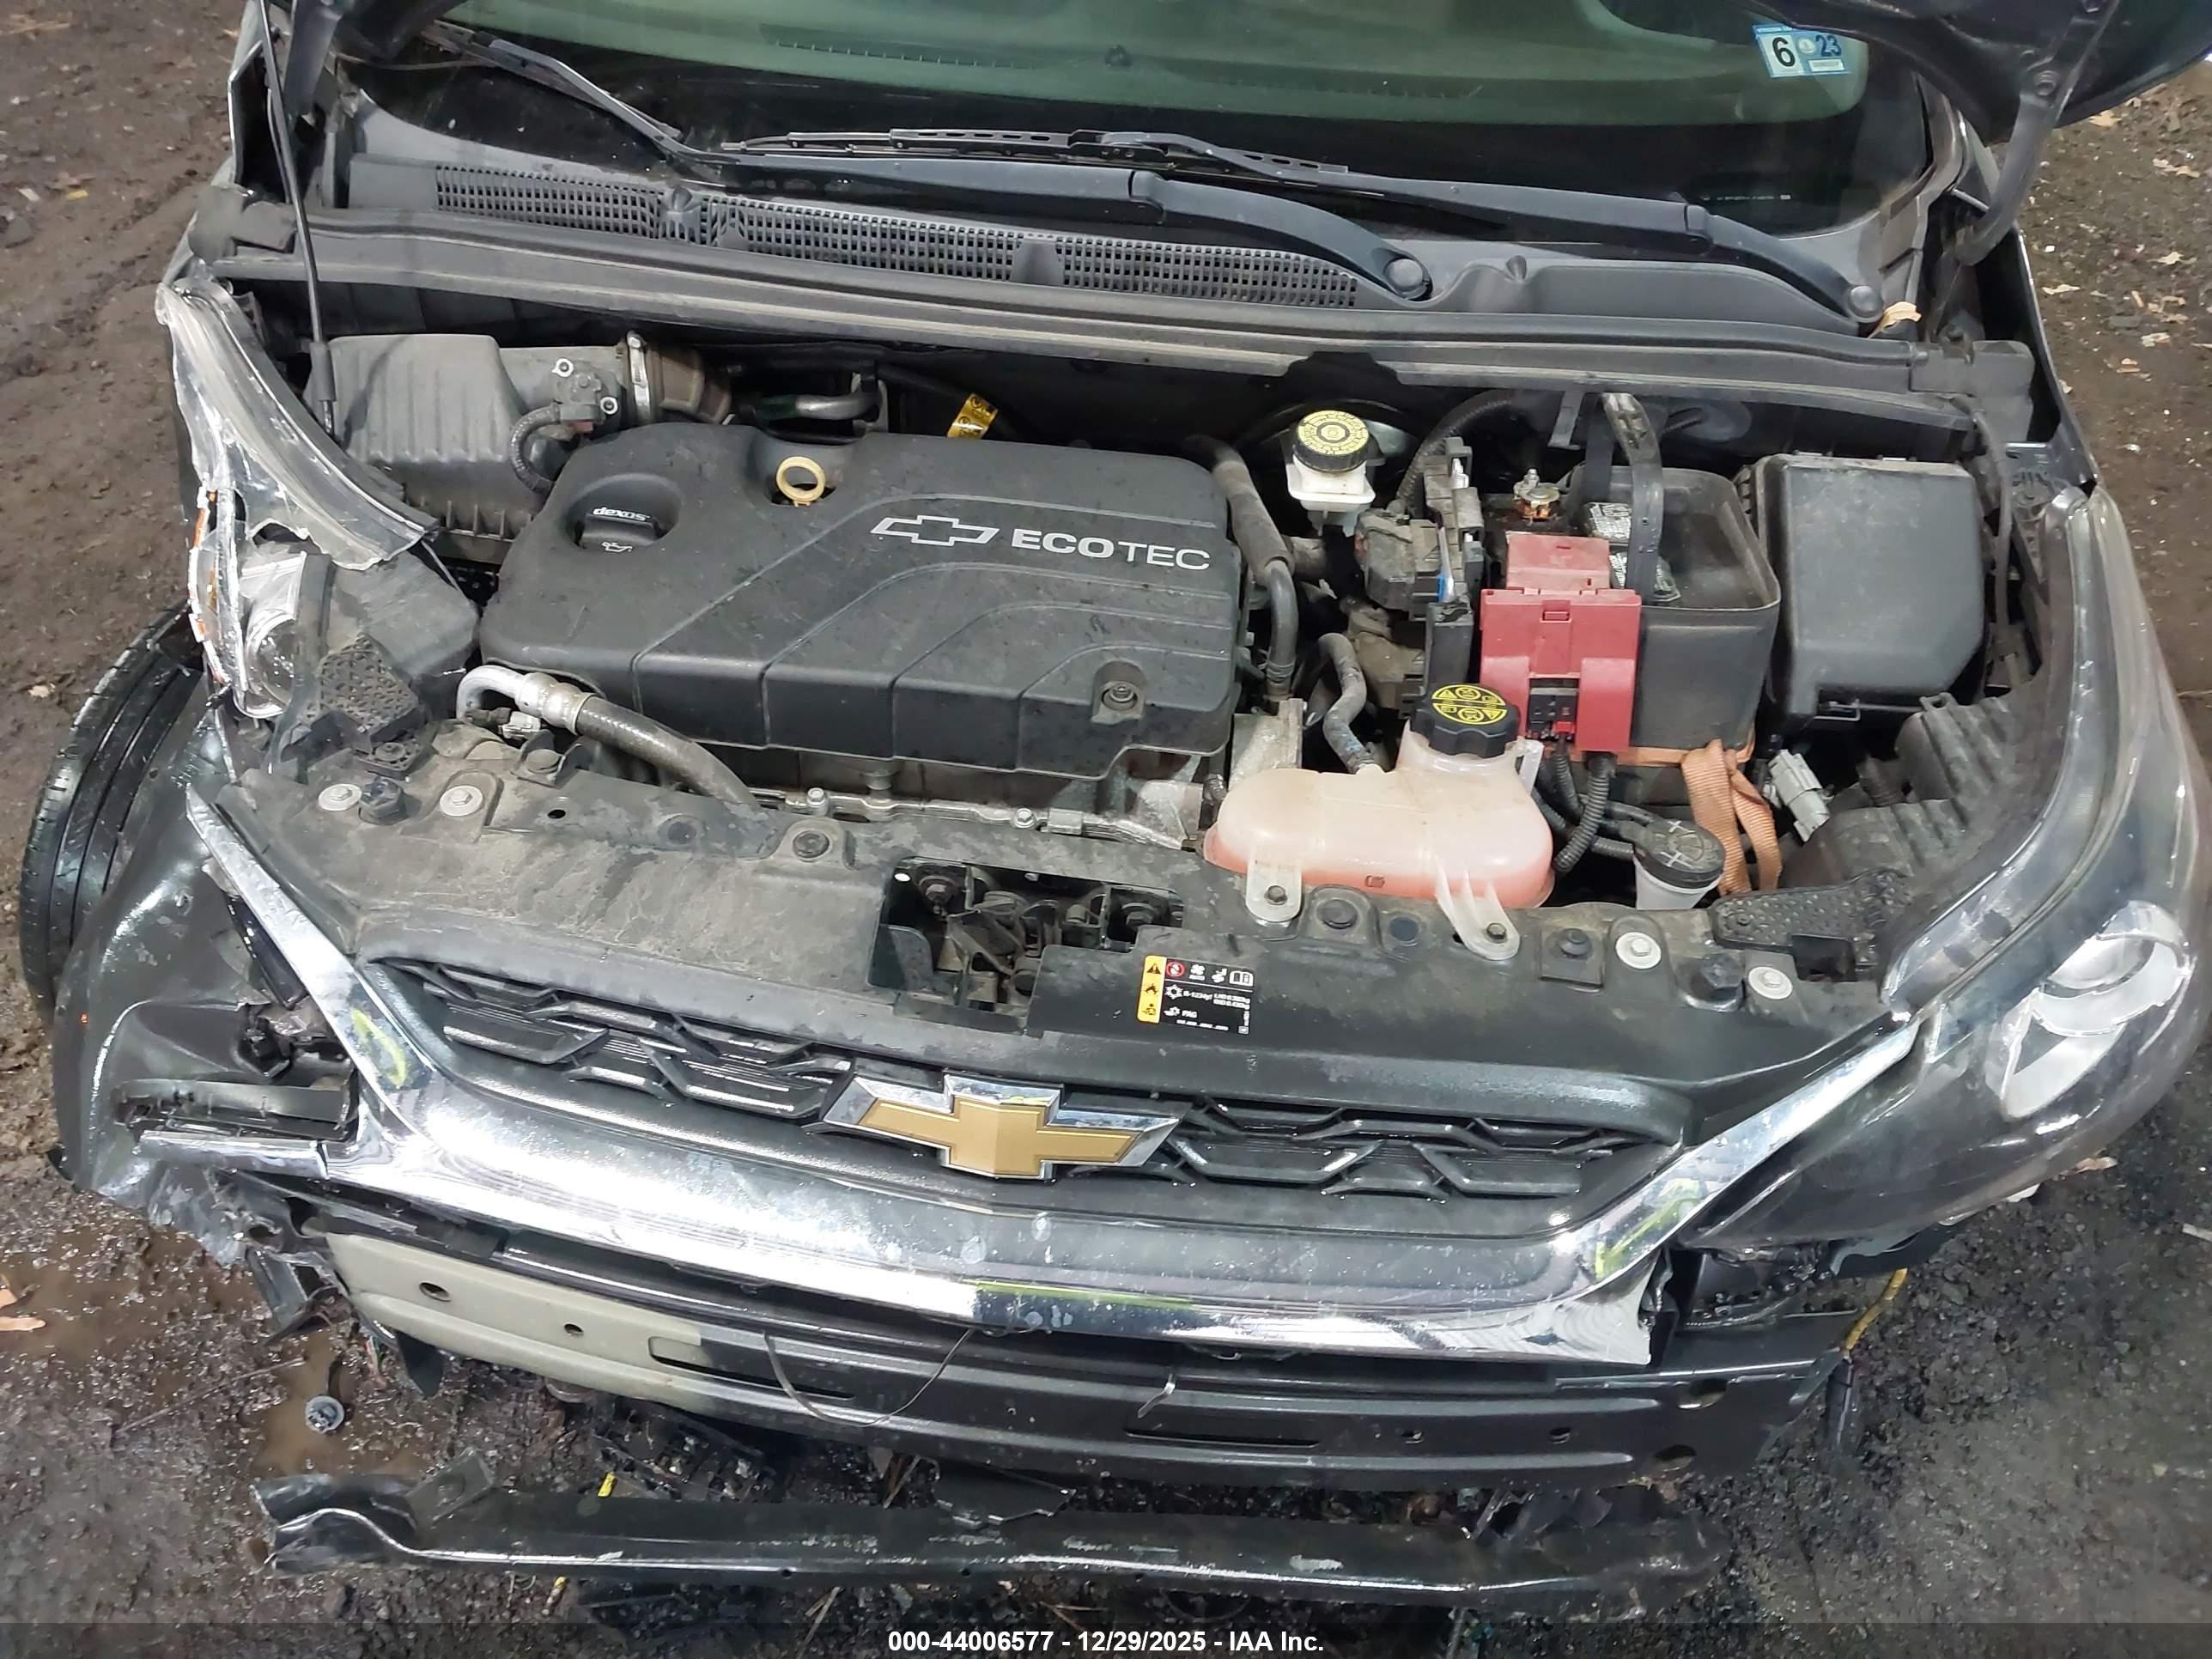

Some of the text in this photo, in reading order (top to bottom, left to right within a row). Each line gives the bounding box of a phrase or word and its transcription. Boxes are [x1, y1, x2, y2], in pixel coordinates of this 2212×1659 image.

[1771, 34, 1842, 67] 6 23
[592, 507, 647, 521] dexos
[1011, 527, 1211, 571] ECOTEC
